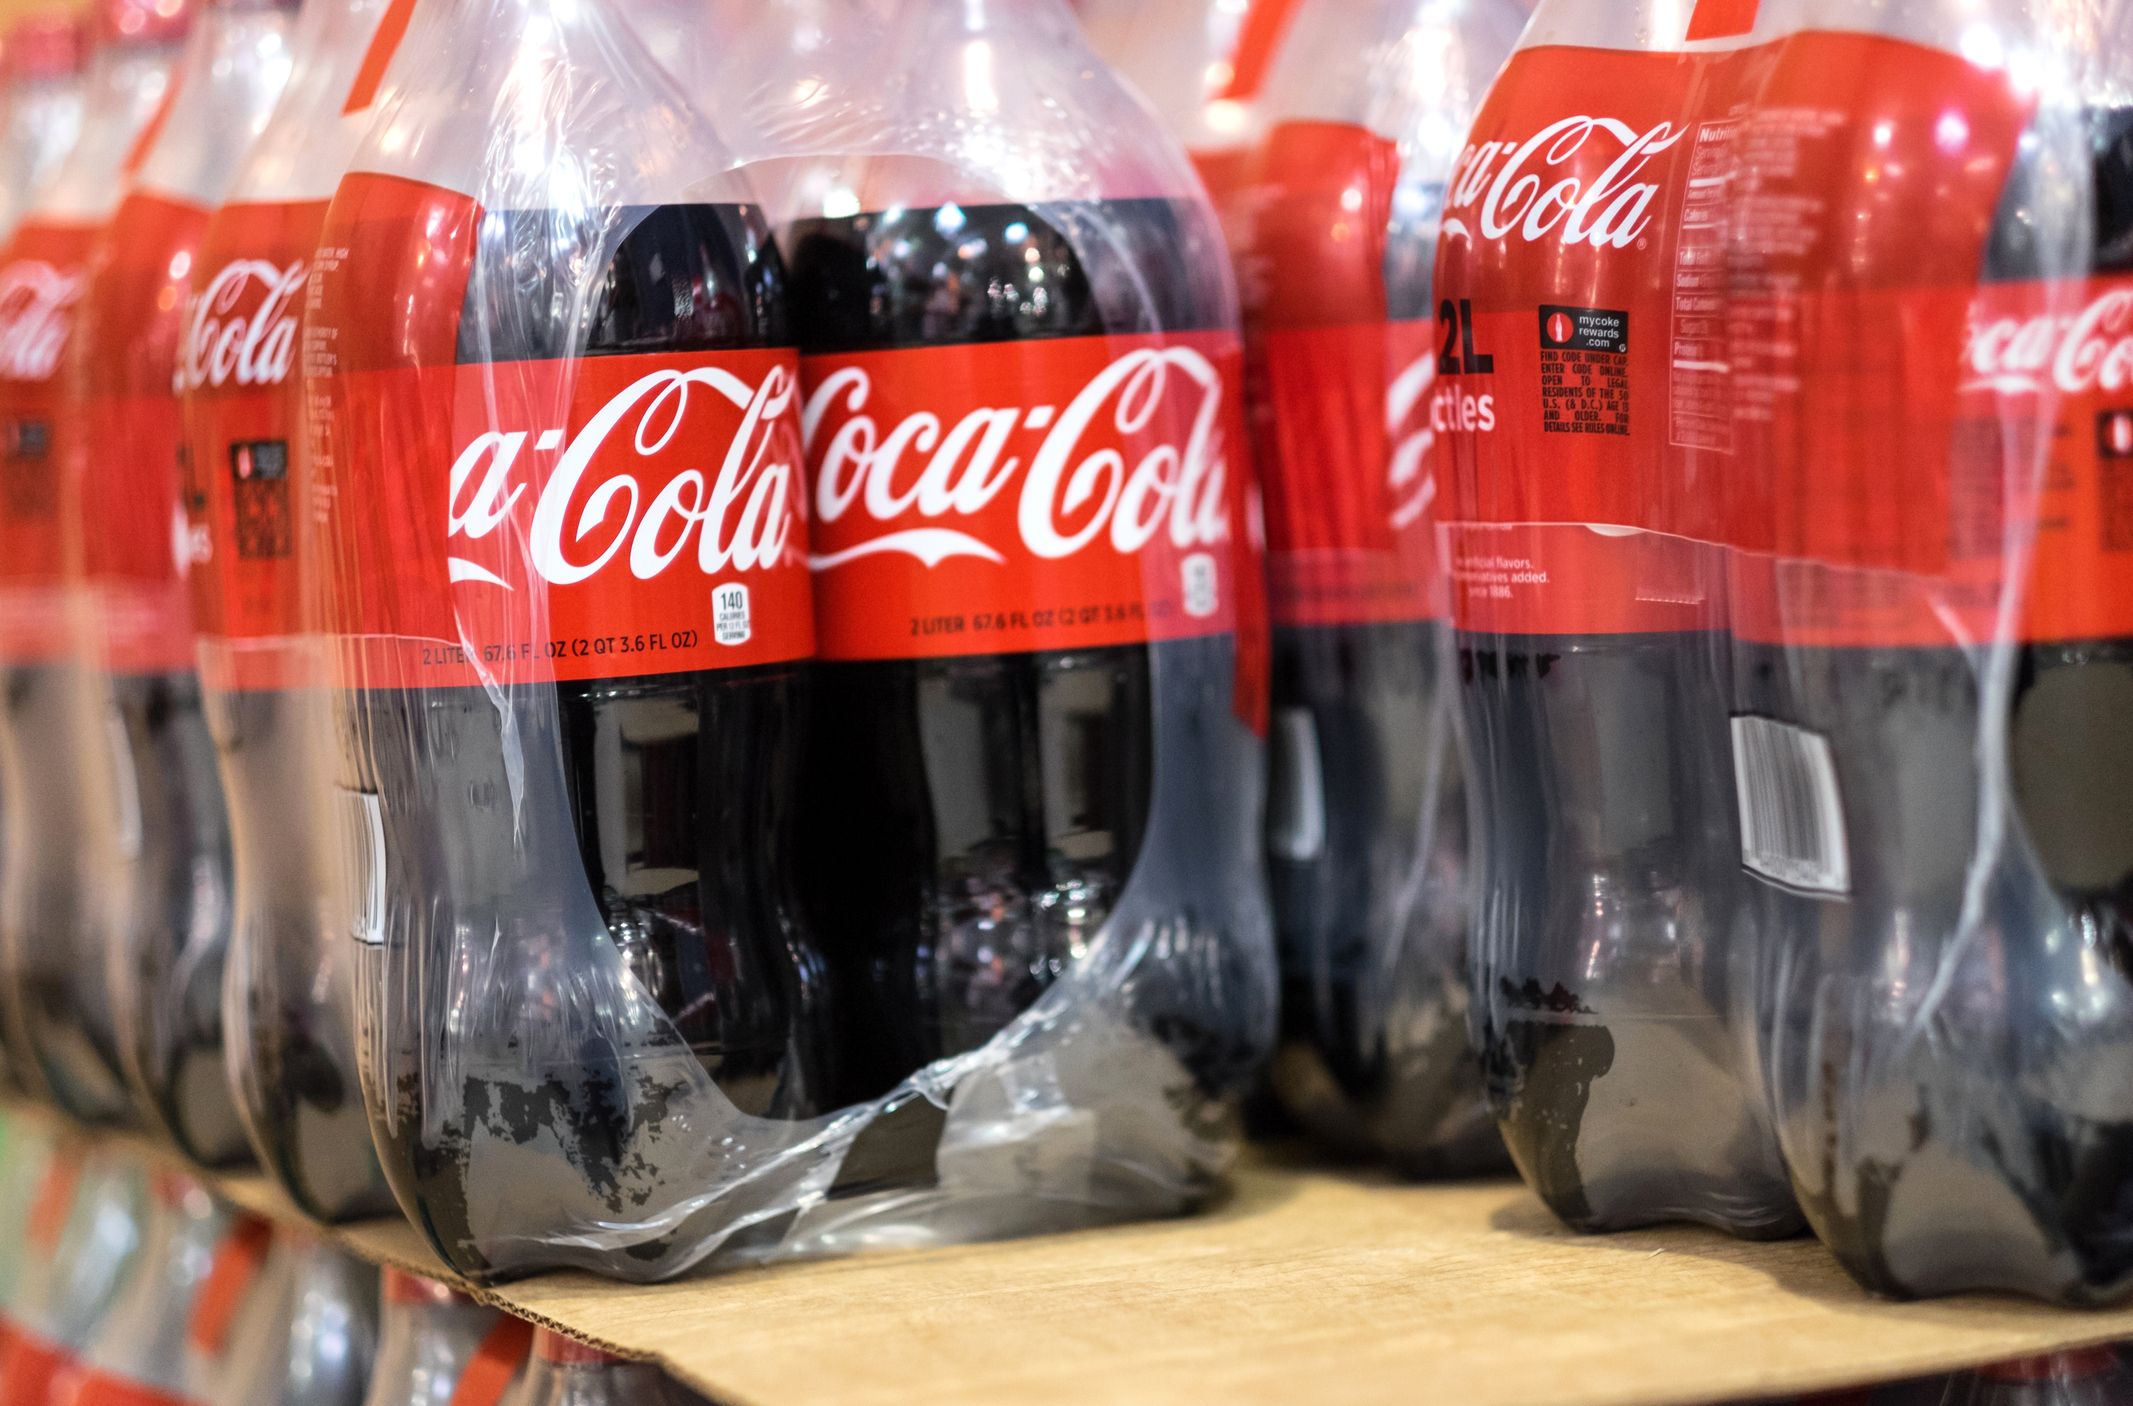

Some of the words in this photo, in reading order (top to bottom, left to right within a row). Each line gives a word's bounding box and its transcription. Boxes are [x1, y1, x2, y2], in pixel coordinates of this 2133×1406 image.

[1578, 315, 1620, 328] mycoke
[1438, 299, 1494, 375] 2L
[1578, 327, 1620, 339] rewards
[1586, 338, 1610, 348] .com
[1540, 351, 1558, 361] FIND
[1562, 352, 1581, 362] CODE
[1585, 353, 1610, 364] UNDER
[1541, 363, 1564, 374] ENTER
[1572, 364, 1592, 375] CODE
[1542, 375, 1563, 385] OPEN
[1581, 376, 1591, 386] TO
[1607, 377, 1628, 389] LEGAL
[1542, 387, 1582, 398] RESIDENTS
[1586, 388, 1596, 398] OF
[1600, 388, 1614, 399] THE
[1619, 390, 1629, 401] 50
[1543, 399, 1560, 409] U.S.
[1606, 401, 1619, 411] AGE
[1544, 410, 1560, 420] AND
[1574, 411, 1602, 421] OLDER.
[1615, 412, 1629, 423] FOR
[1544, 421, 1570, 433] DETAILS
[1571, 422, 1583, 432] SEE
[1585, 422, 1605, 434] RULES
[1511, 571, 1550, 583] added.
[721, 590, 743, 610] 140
[910, 617, 919, 636] 2
[923, 614, 965, 635] LITER
[1010, 610, 1029, 629] FL
[1033, 608, 1055, 628] OZ
[422, 648, 432, 665] 2
[483, 644, 516, 662] 67.6
[545, 640, 567, 658] OZ
[571, 639, 590, 657] (2
[594, 637, 615, 655] QT
[620, 635, 645, 653] 3.6
[650, 633, 667, 651] FL
[671, 630, 698, 649] OZ)
